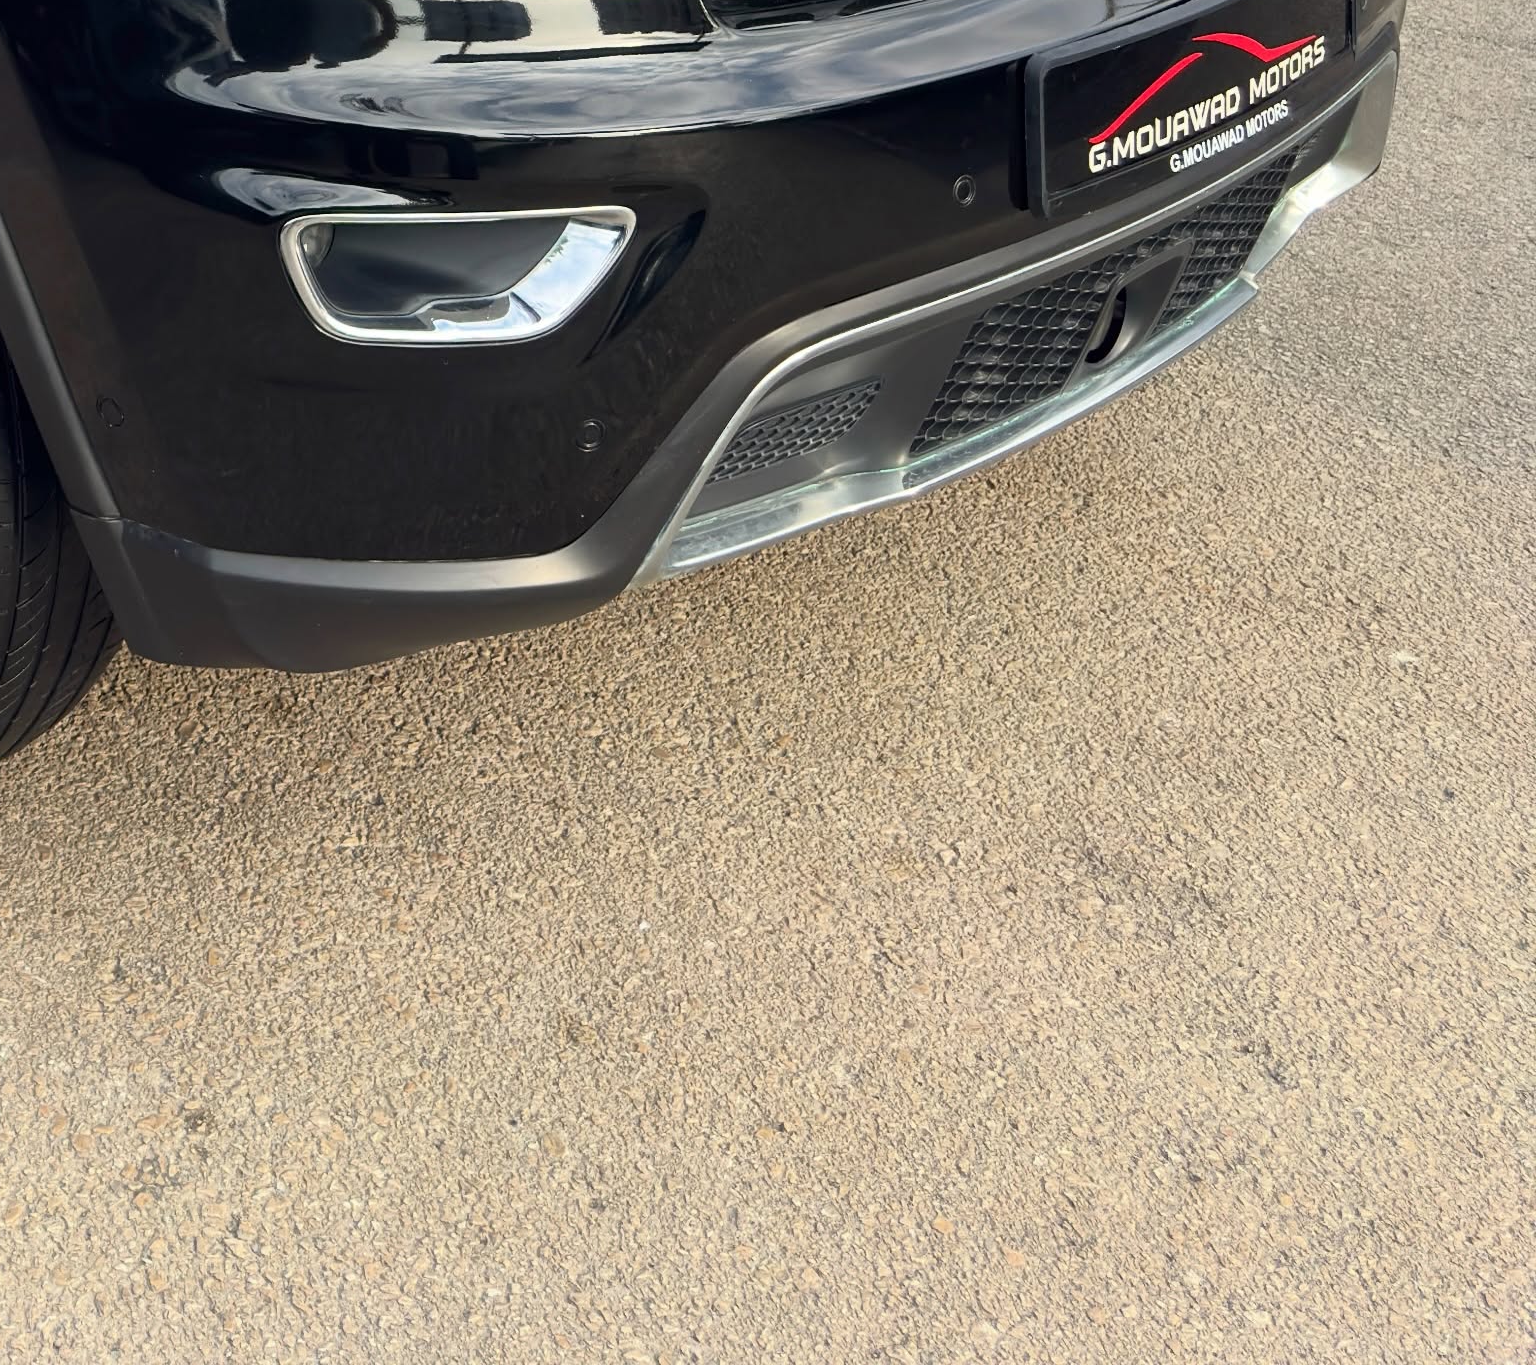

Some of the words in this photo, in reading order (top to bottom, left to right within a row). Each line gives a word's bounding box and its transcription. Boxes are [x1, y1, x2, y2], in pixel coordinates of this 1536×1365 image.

[1088, 86, 1240, 173] G.MOUAWAD
[1249, 36, 1325, 105] MOTORS
[1170, 124, 1244, 173] G.MOUAWAD
[1247, 99, 1289, 138] MOTORS
